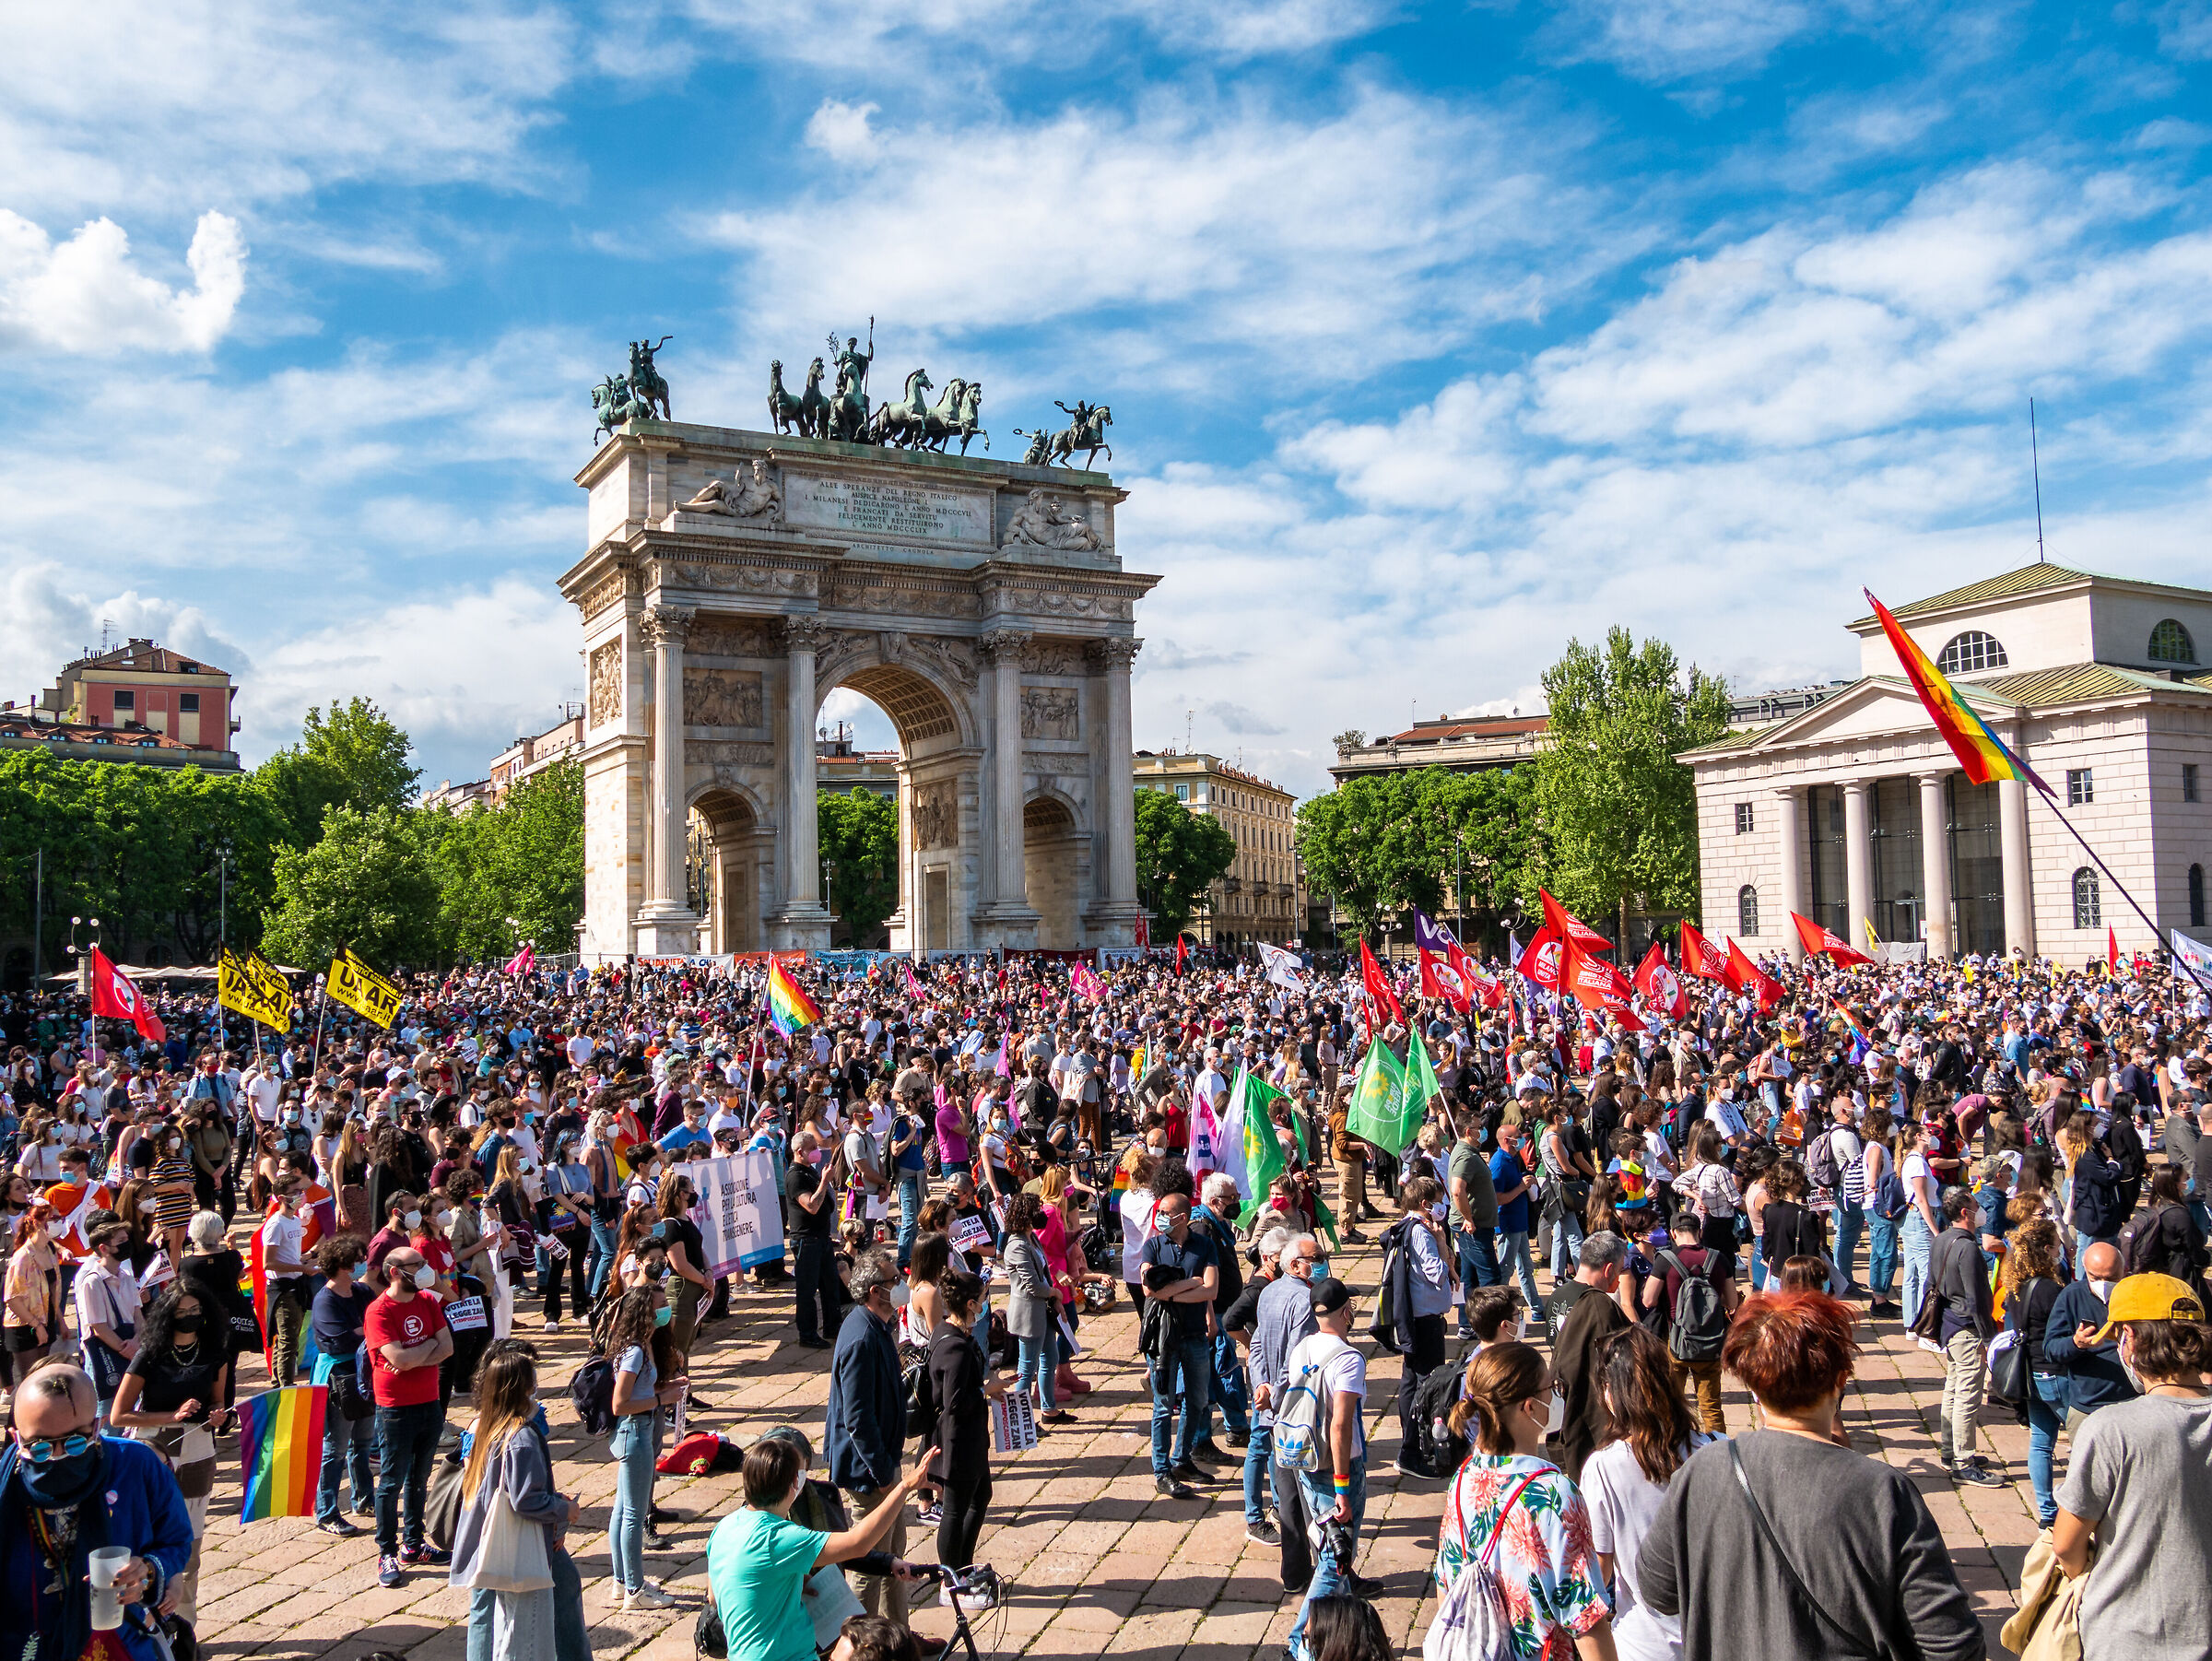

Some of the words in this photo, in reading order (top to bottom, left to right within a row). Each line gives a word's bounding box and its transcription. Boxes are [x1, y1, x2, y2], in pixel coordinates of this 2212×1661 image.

[820, 481, 839, 489] ALLE
[842, 483, 880, 493] SPERANZE
[931, 493, 958, 501] ITALICO
[852, 492, 877, 501] AUSPICE
[882, 494, 920, 504] NAPOLEONE
[813, 496, 848, 505] MILANESI
[853, 499, 900, 510] DEDICARONO
[839, 512, 887, 524] FELICEMENTE
[892, 518, 944, 529] RESTITUIRONO
[853, 507, 888, 516] FRANCATI
[909, 512, 937, 521] SERVITU
[862, 522, 883, 530] ANNO
[340, 966, 397, 1015] UAAR
[1577, 977, 1611, 989] ITALIANA
[721, 1178, 748, 1196] ASSOCIAZIONE
[731, 1198, 735, 1209] LA
[735, 1191, 757, 1207] CULTURA
[723, 1221, 754, 1243] TRANSGENERE
[973, 1225, 985, 1233] ZAN
[445, 1299, 472, 1313] VOTATE
[448, 1310, 472, 1320] LEGGE
[1006, 1394, 1019, 1427] LEGGE
[1018, 1392, 1032, 1431] VOTATE
[1025, 1431, 1034, 1445] LA
[1011, 1428, 1021, 1449] ZAN
[1279, 1458, 1309, 1467] adidas
